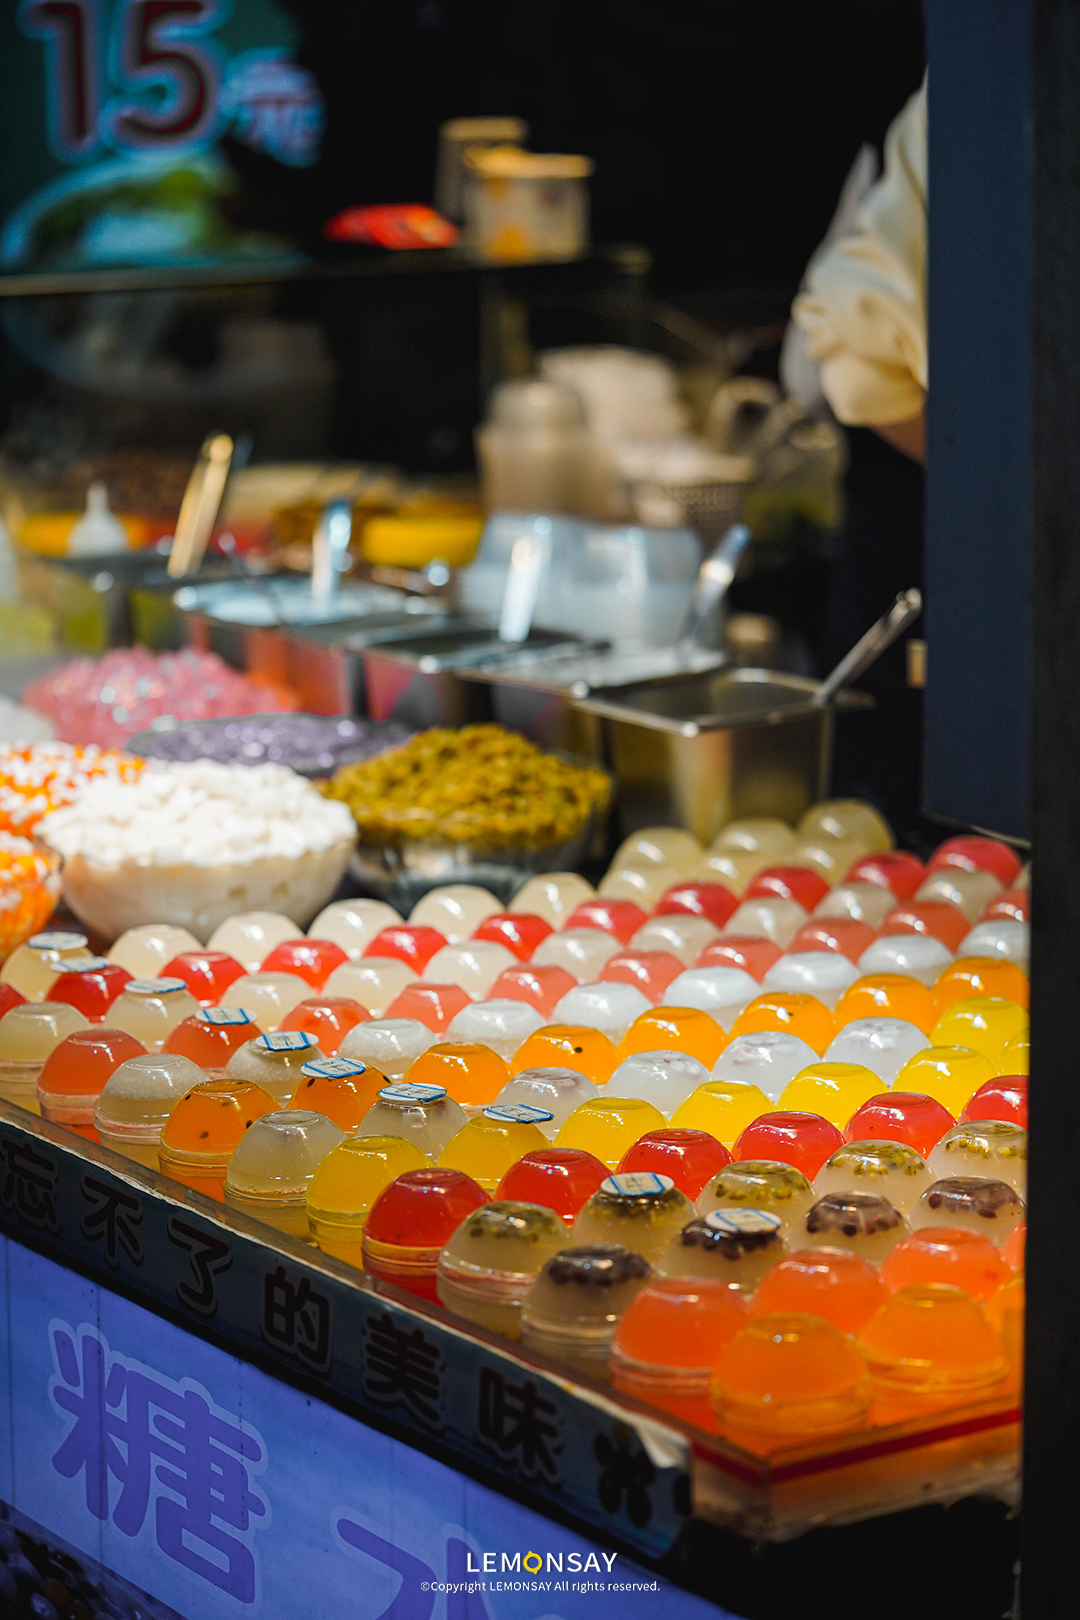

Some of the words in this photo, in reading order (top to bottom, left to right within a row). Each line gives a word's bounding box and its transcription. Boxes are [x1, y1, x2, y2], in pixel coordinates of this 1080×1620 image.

[3, 1139, 557, 1482] 忘不了的美味
